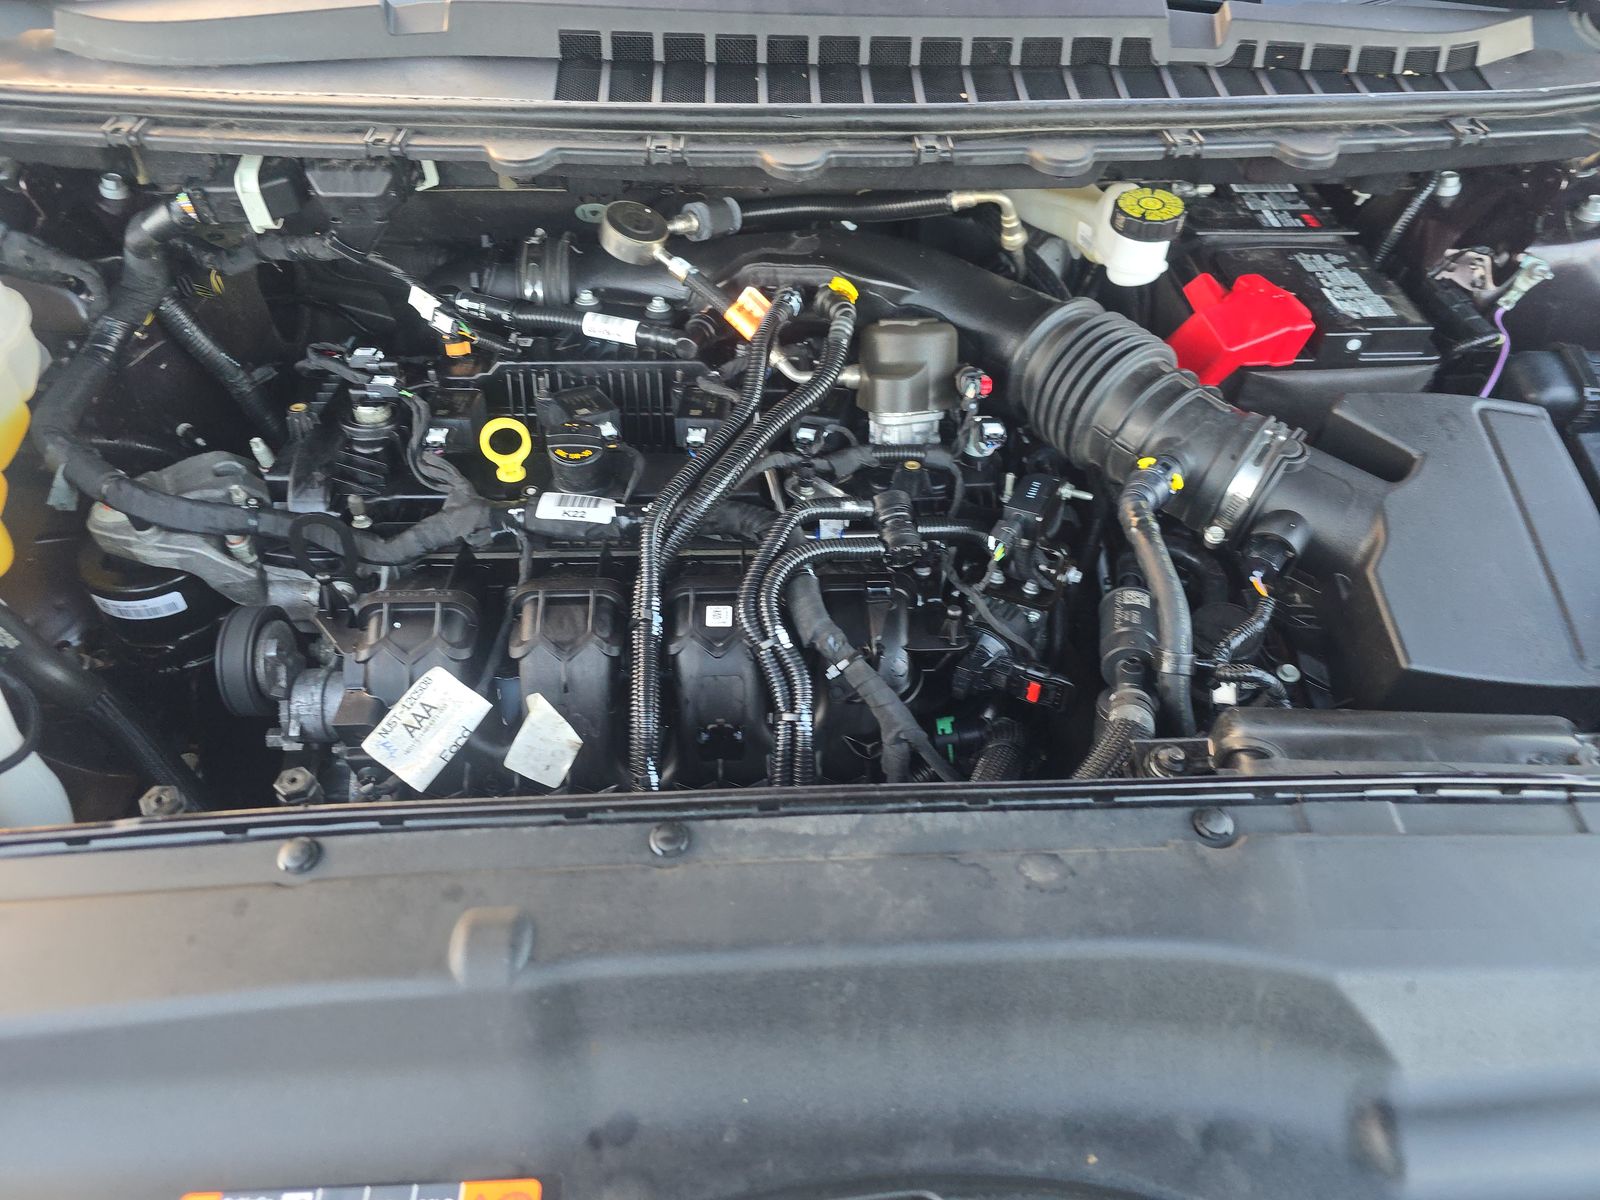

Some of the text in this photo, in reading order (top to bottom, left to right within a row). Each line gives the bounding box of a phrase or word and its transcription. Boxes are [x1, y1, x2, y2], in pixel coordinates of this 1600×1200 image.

[562, 510, 586, 519] K22
[401, 702, 438, 738] AAA
[439, 725, 474, 763] Ford
